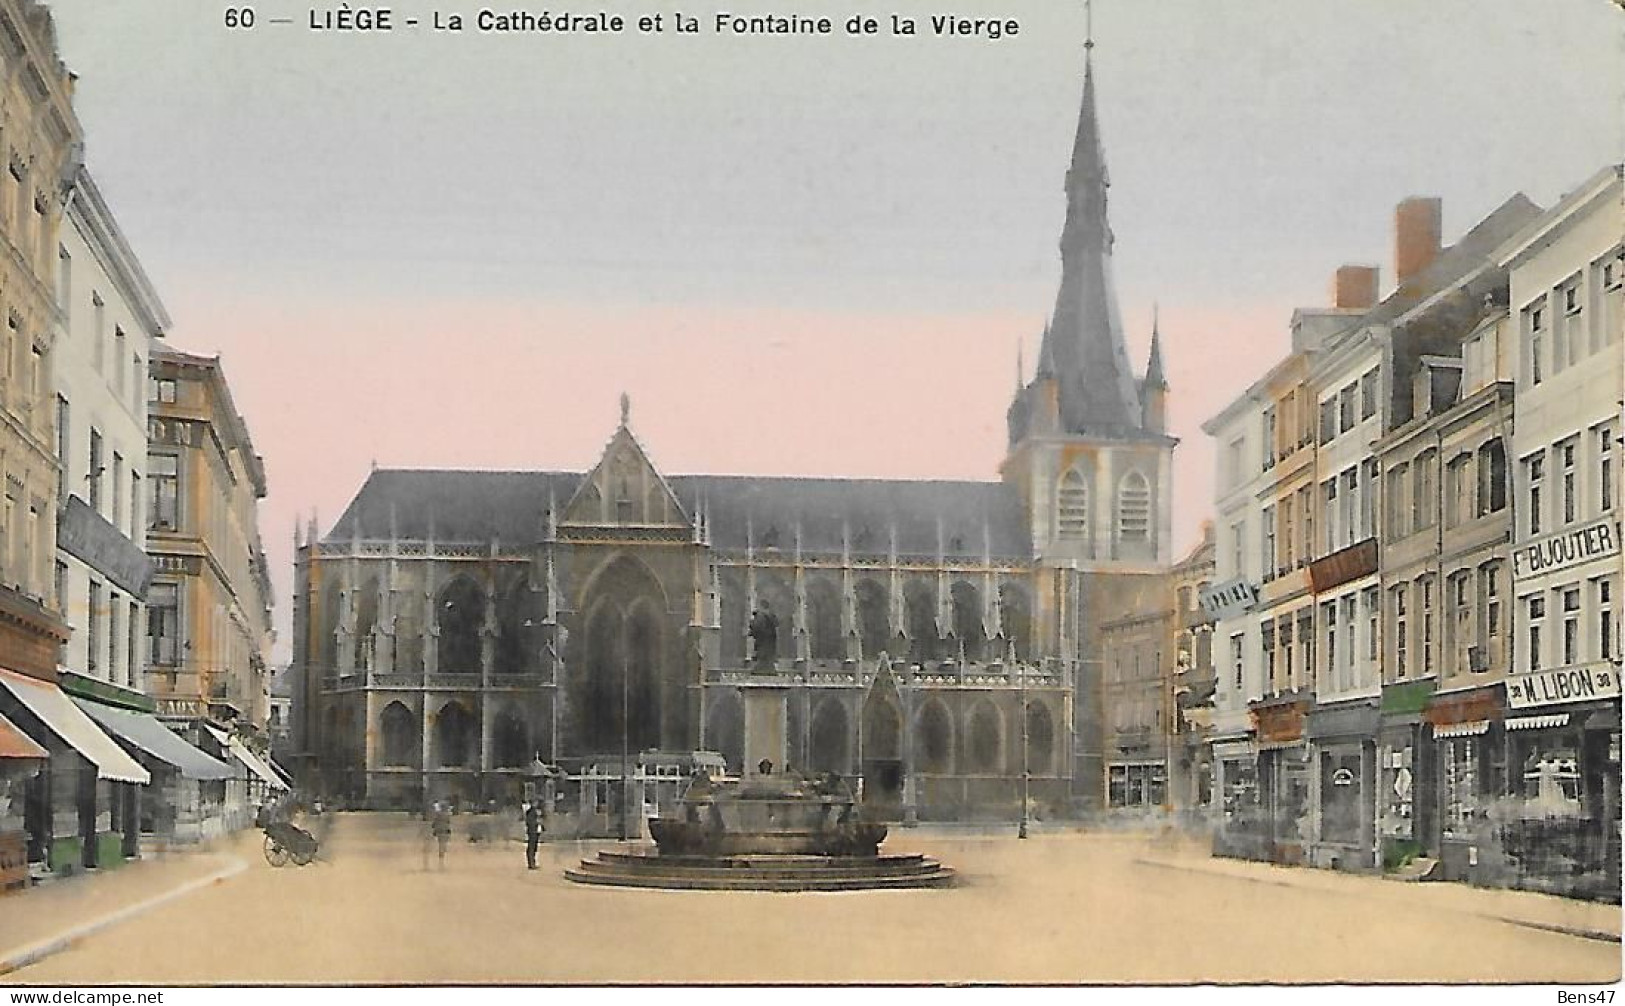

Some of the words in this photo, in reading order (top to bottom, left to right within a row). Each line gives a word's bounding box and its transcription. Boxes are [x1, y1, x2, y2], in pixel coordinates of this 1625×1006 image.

[1529, 524, 1613, 572] BIJOUTIER
[1523, 676, 1541, 703] M.
[1540, 668, 1596, 701] LIBON
[1596, 672, 1611, 688] 38
